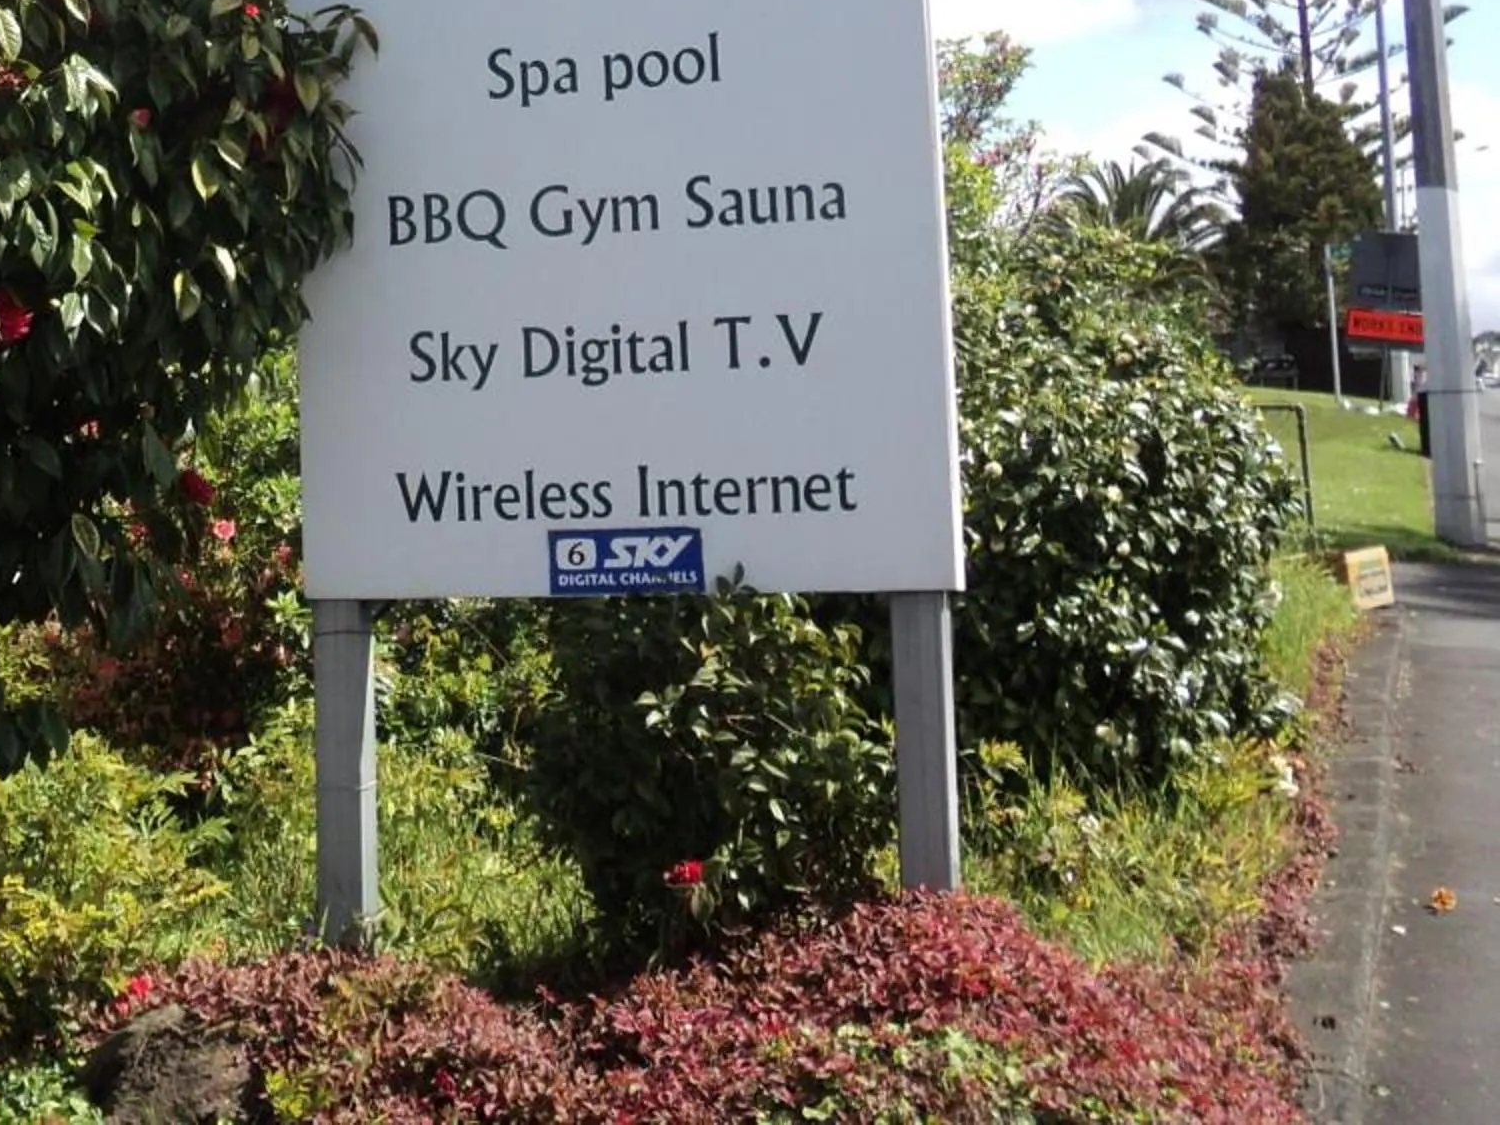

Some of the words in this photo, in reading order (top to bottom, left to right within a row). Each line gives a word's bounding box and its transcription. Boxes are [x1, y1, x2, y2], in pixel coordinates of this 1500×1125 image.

[487, 47, 579, 108] Spa
[602, 31, 721, 102] pool
[387, 189, 507, 250] BBQ
[529, 184, 659, 246] Gym
[685, 174, 846, 229] Sauna
[409, 330, 499, 391] Sky
[521, 320, 690, 387] Digital
[713, 312, 823, 369] T.V
[395, 469, 613, 523] Wireless
[637, 465, 858, 518] Internet
[558, 574, 617, 587] DIGITAL
[568, 542, 585, 566] 6
[603, 534, 693, 569] SKY
